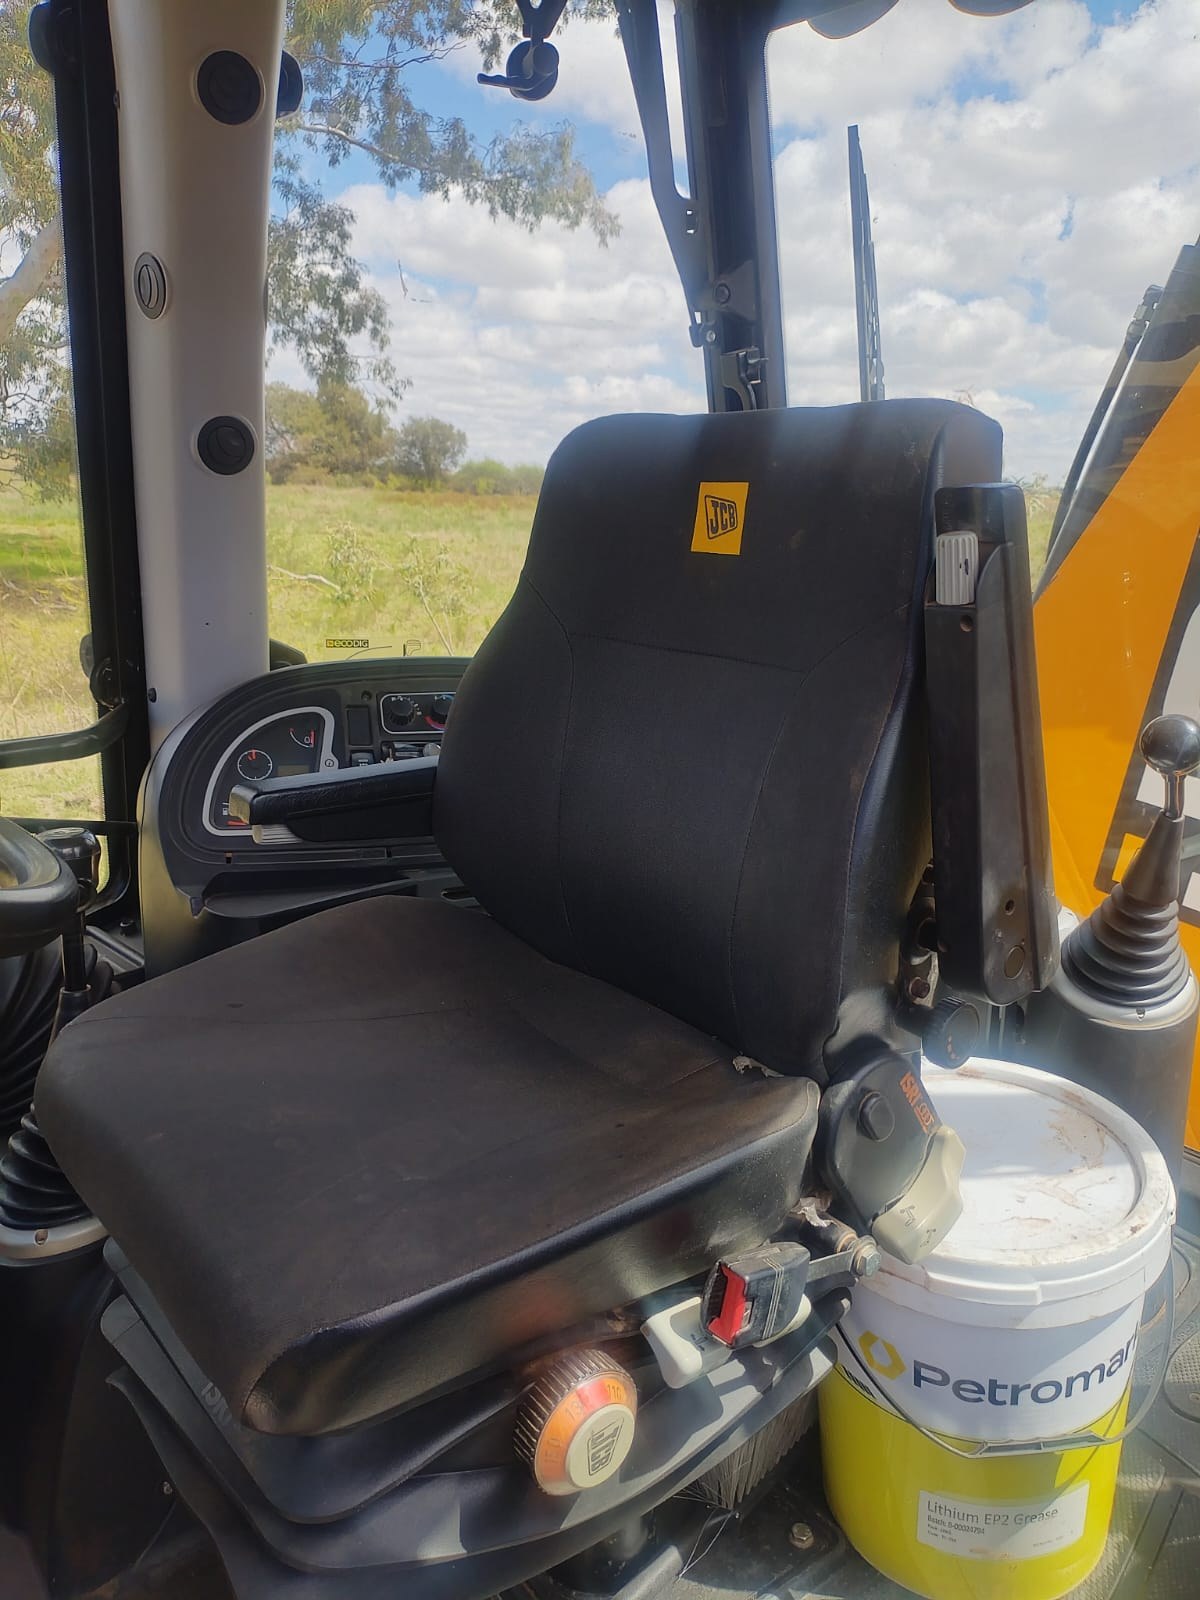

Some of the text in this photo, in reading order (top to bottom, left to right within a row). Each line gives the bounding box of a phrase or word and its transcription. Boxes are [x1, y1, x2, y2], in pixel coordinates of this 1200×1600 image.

[709, 499, 736, 535] JCB
[590, 1424, 620, 1473] JCB
[927, 1500, 1058, 1526] Lithium EP2 Grease
